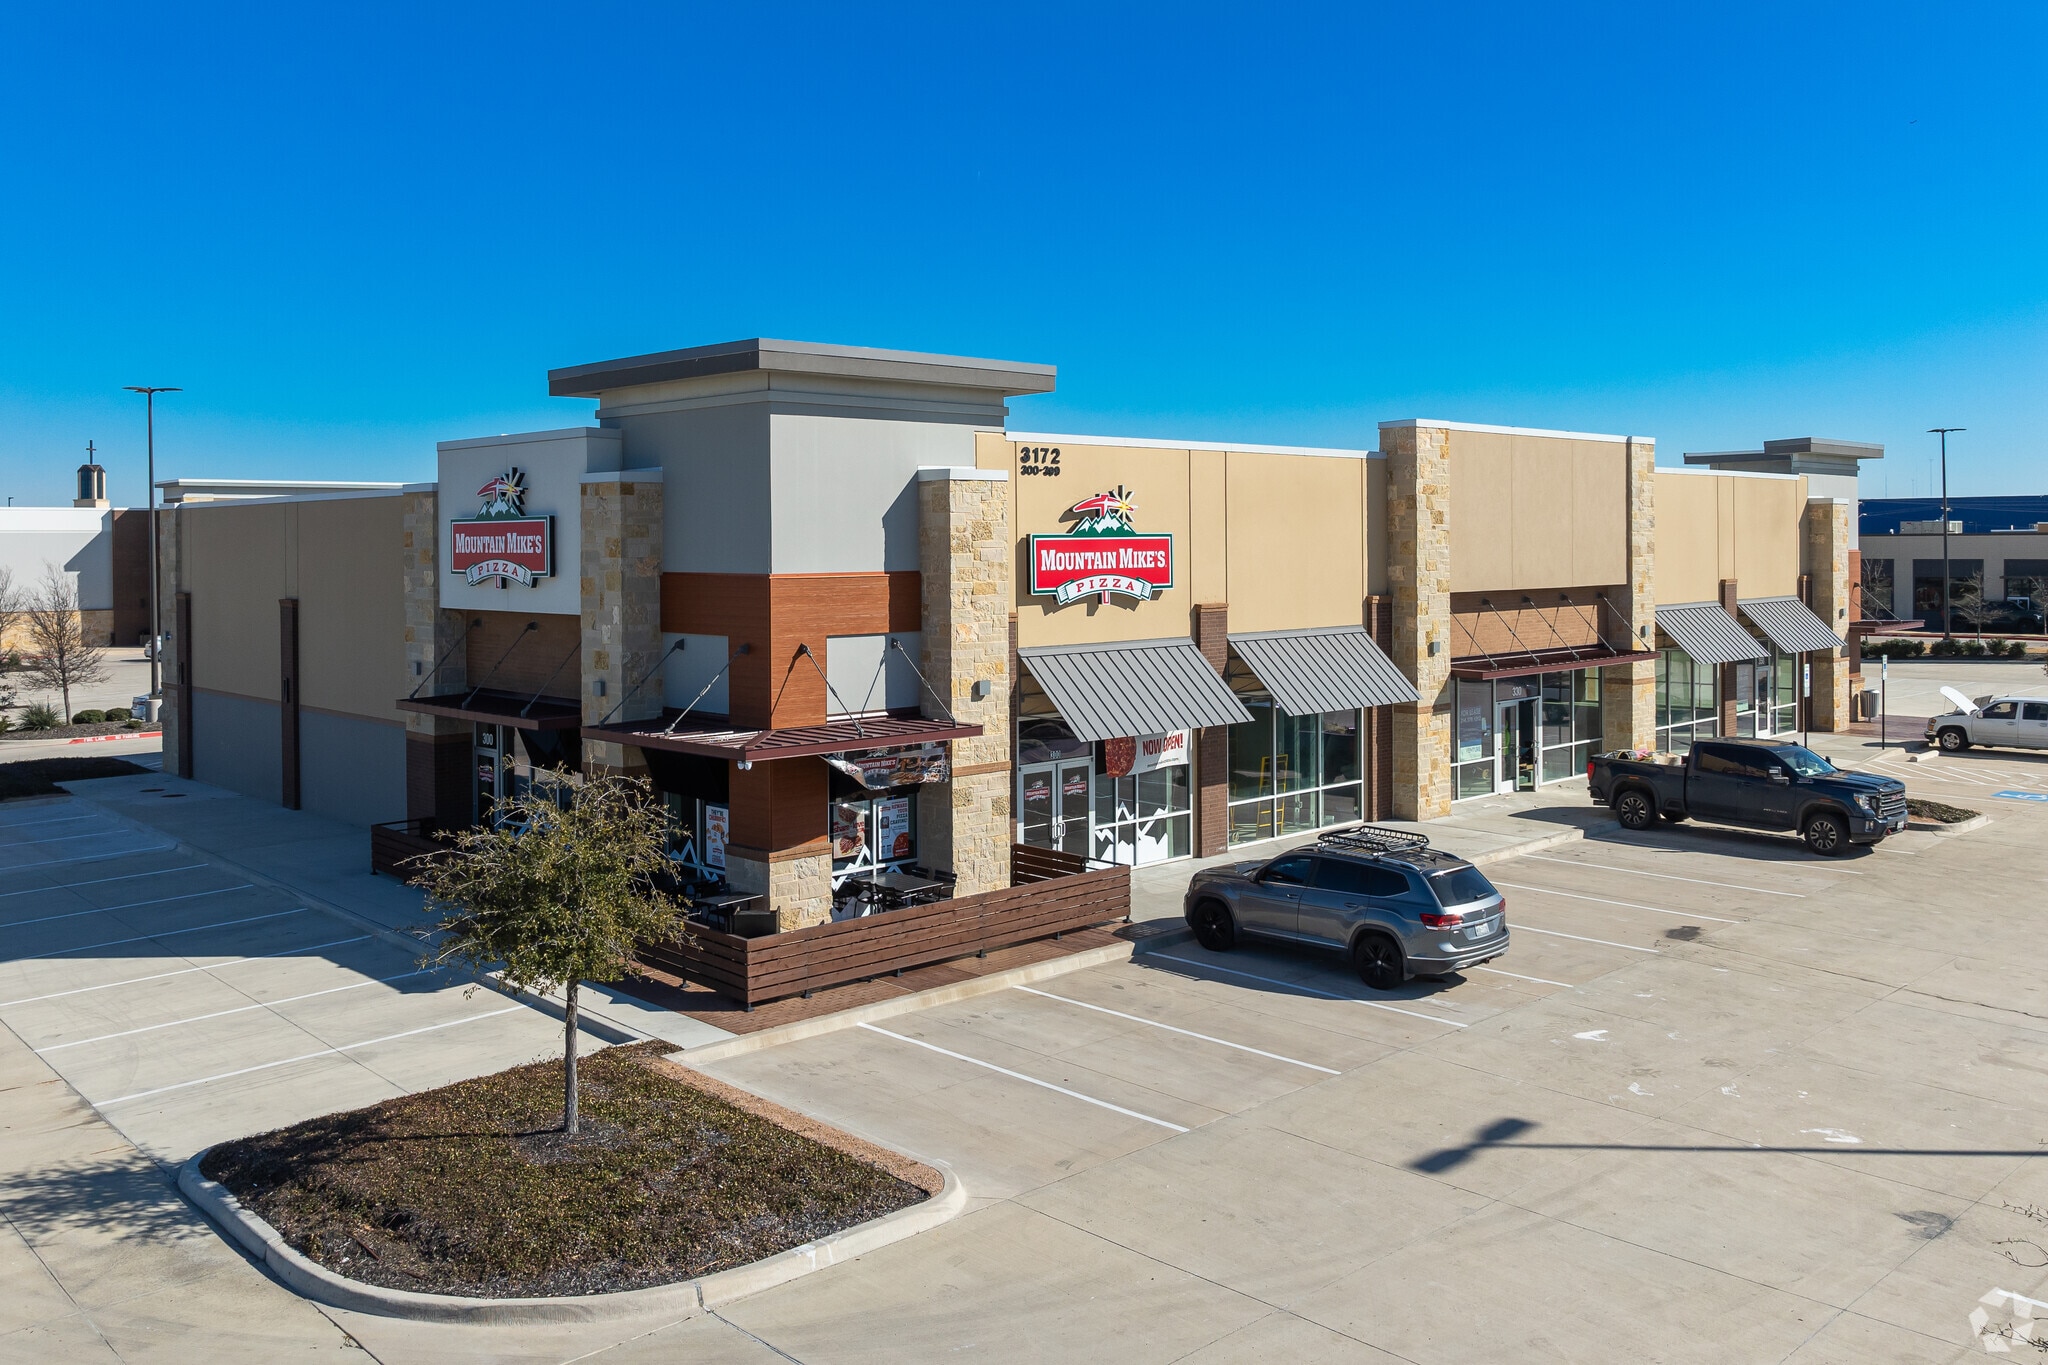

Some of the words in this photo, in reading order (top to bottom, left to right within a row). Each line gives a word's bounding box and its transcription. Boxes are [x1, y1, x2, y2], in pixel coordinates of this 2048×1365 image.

[1020, 446, 1061, 465] 3172
[1020, 465, 1061, 477] 300-399
[455, 533, 505, 554] MOUNTAIN
[506, 532, 542, 554] MIKE'S
[1040, 549, 1117, 571] MOUNTAIN
[1119, 548, 1167, 569] MIKE'S
[477, 562, 519, 577] PIZZA
[1076, 578, 1135, 593] PIZZA
[1511, 686, 1522, 697] 330
[482, 732, 494, 745] 300
[1142, 738, 1162, 756] NOW
[1163, 733, 1183, 752] OPEN!
